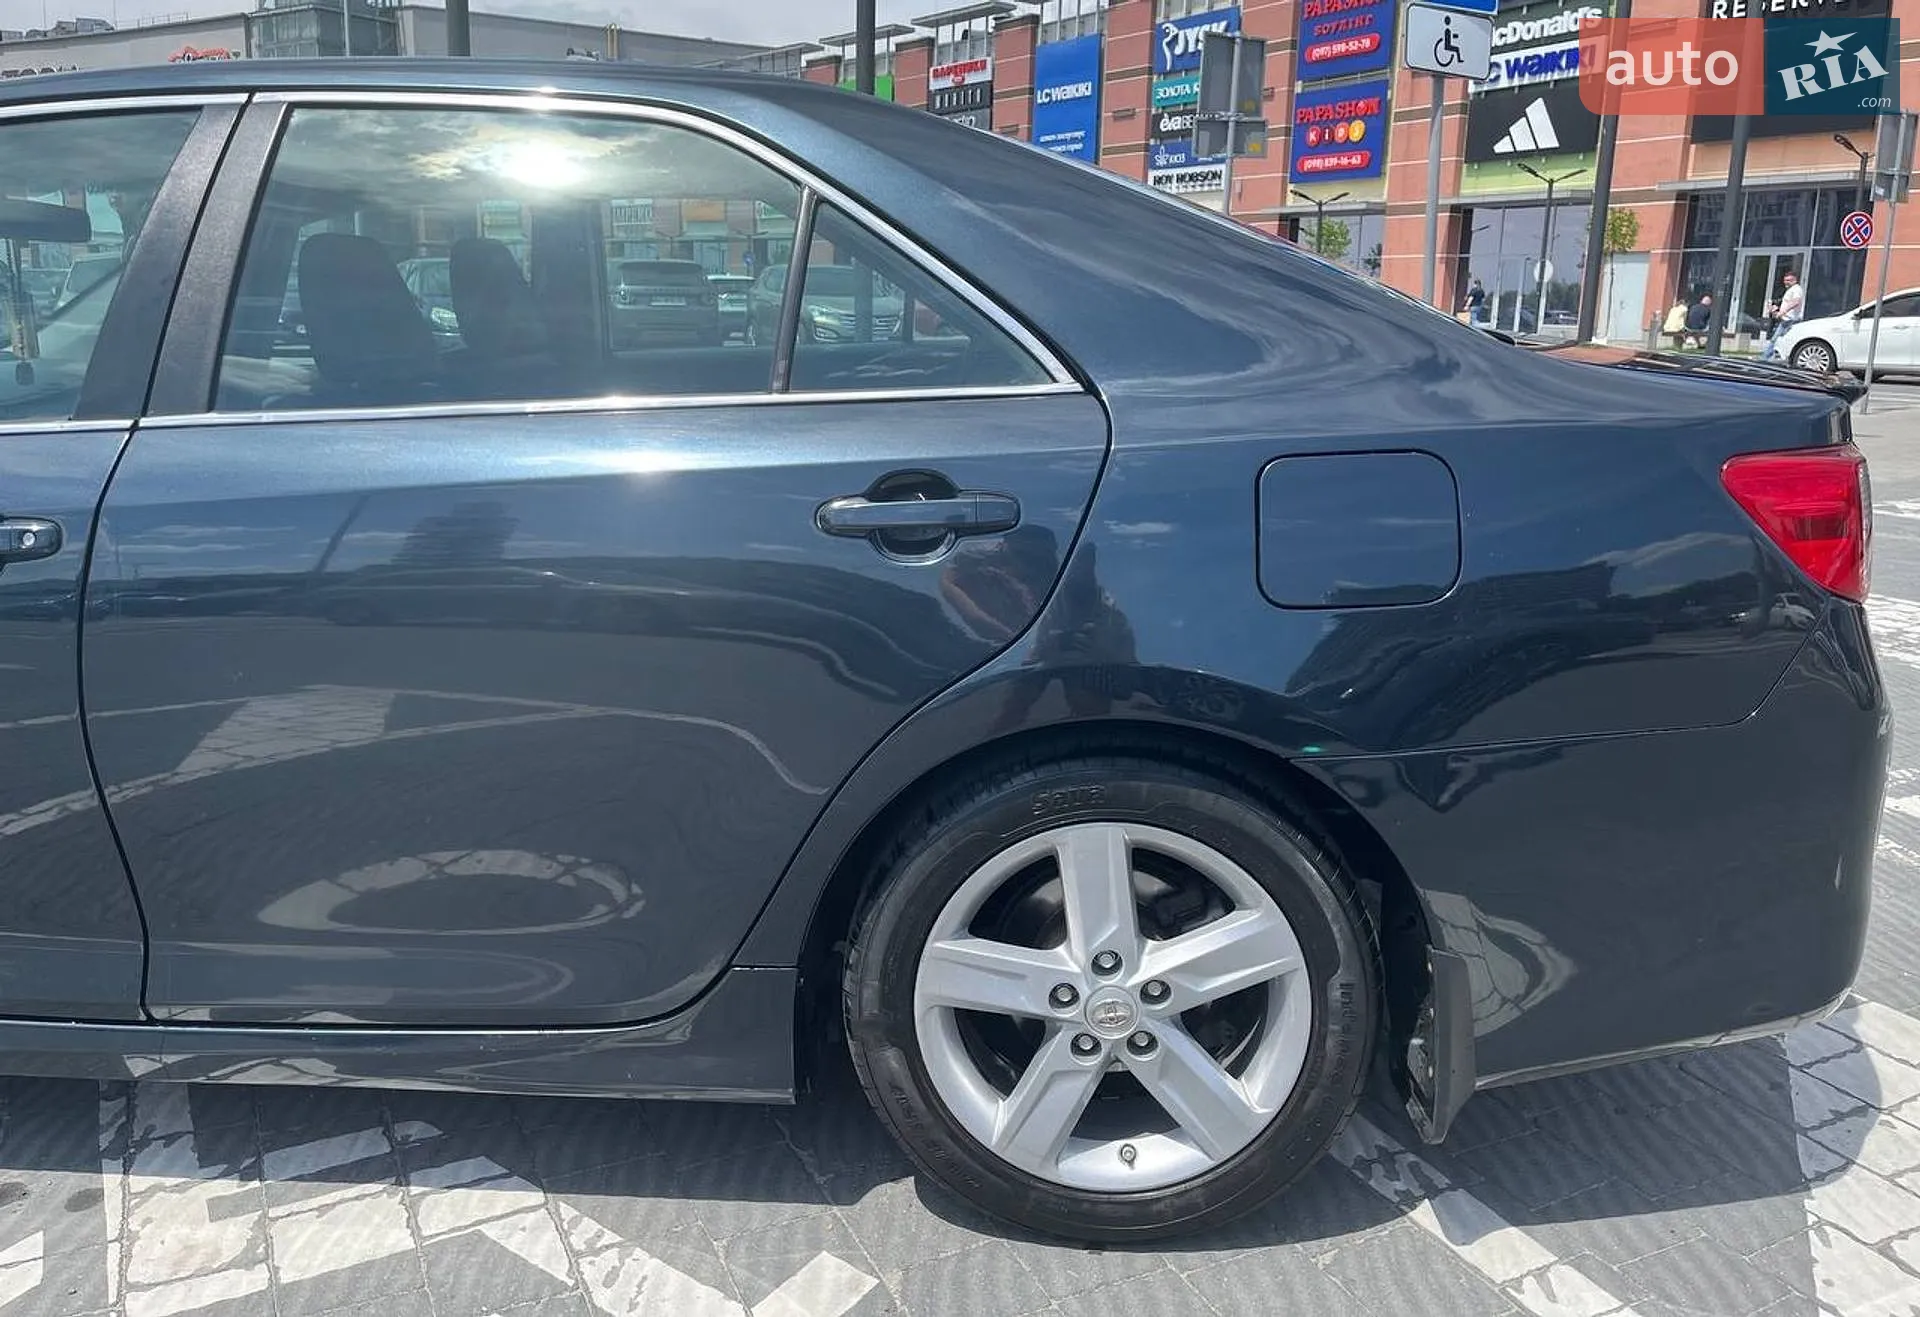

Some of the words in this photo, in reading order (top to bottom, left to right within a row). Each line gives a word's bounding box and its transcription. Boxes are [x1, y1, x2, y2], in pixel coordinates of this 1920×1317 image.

[1036, 89, 1051, 105] LC
[1153, 173, 1173, 186] ROY
[1176, 169, 1223, 184] ROBSON
